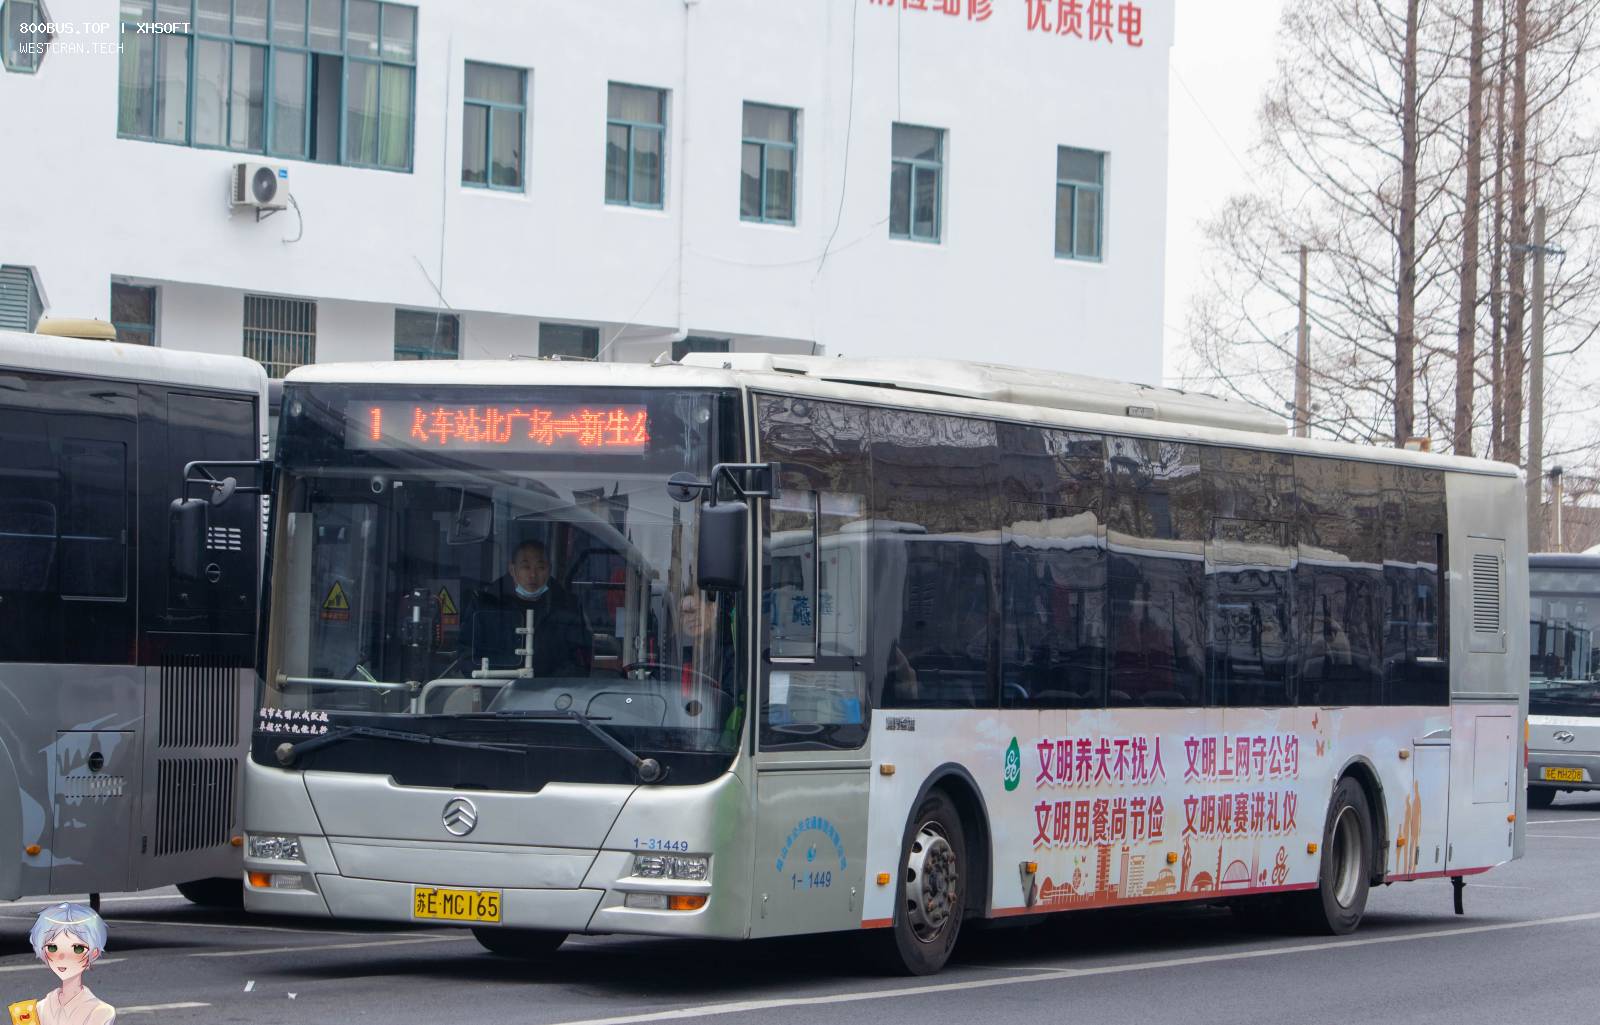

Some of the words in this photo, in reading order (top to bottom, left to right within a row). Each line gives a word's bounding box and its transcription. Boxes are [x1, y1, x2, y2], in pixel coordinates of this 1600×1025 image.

[1025, 0, 1143, 47] 优质供电
[369, 407, 381, 441] 1
[1035, 736, 1166, 784] 文明养犬不扰人
[1183, 734, 1299, 779] 文明上网守公约
[1032, 795, 1165, 845] 文明用餐尚节俭
[1181, 790, 1298, 836] 文明观赛讲礼仪
[633, 837, 689, 852] 1-31449
